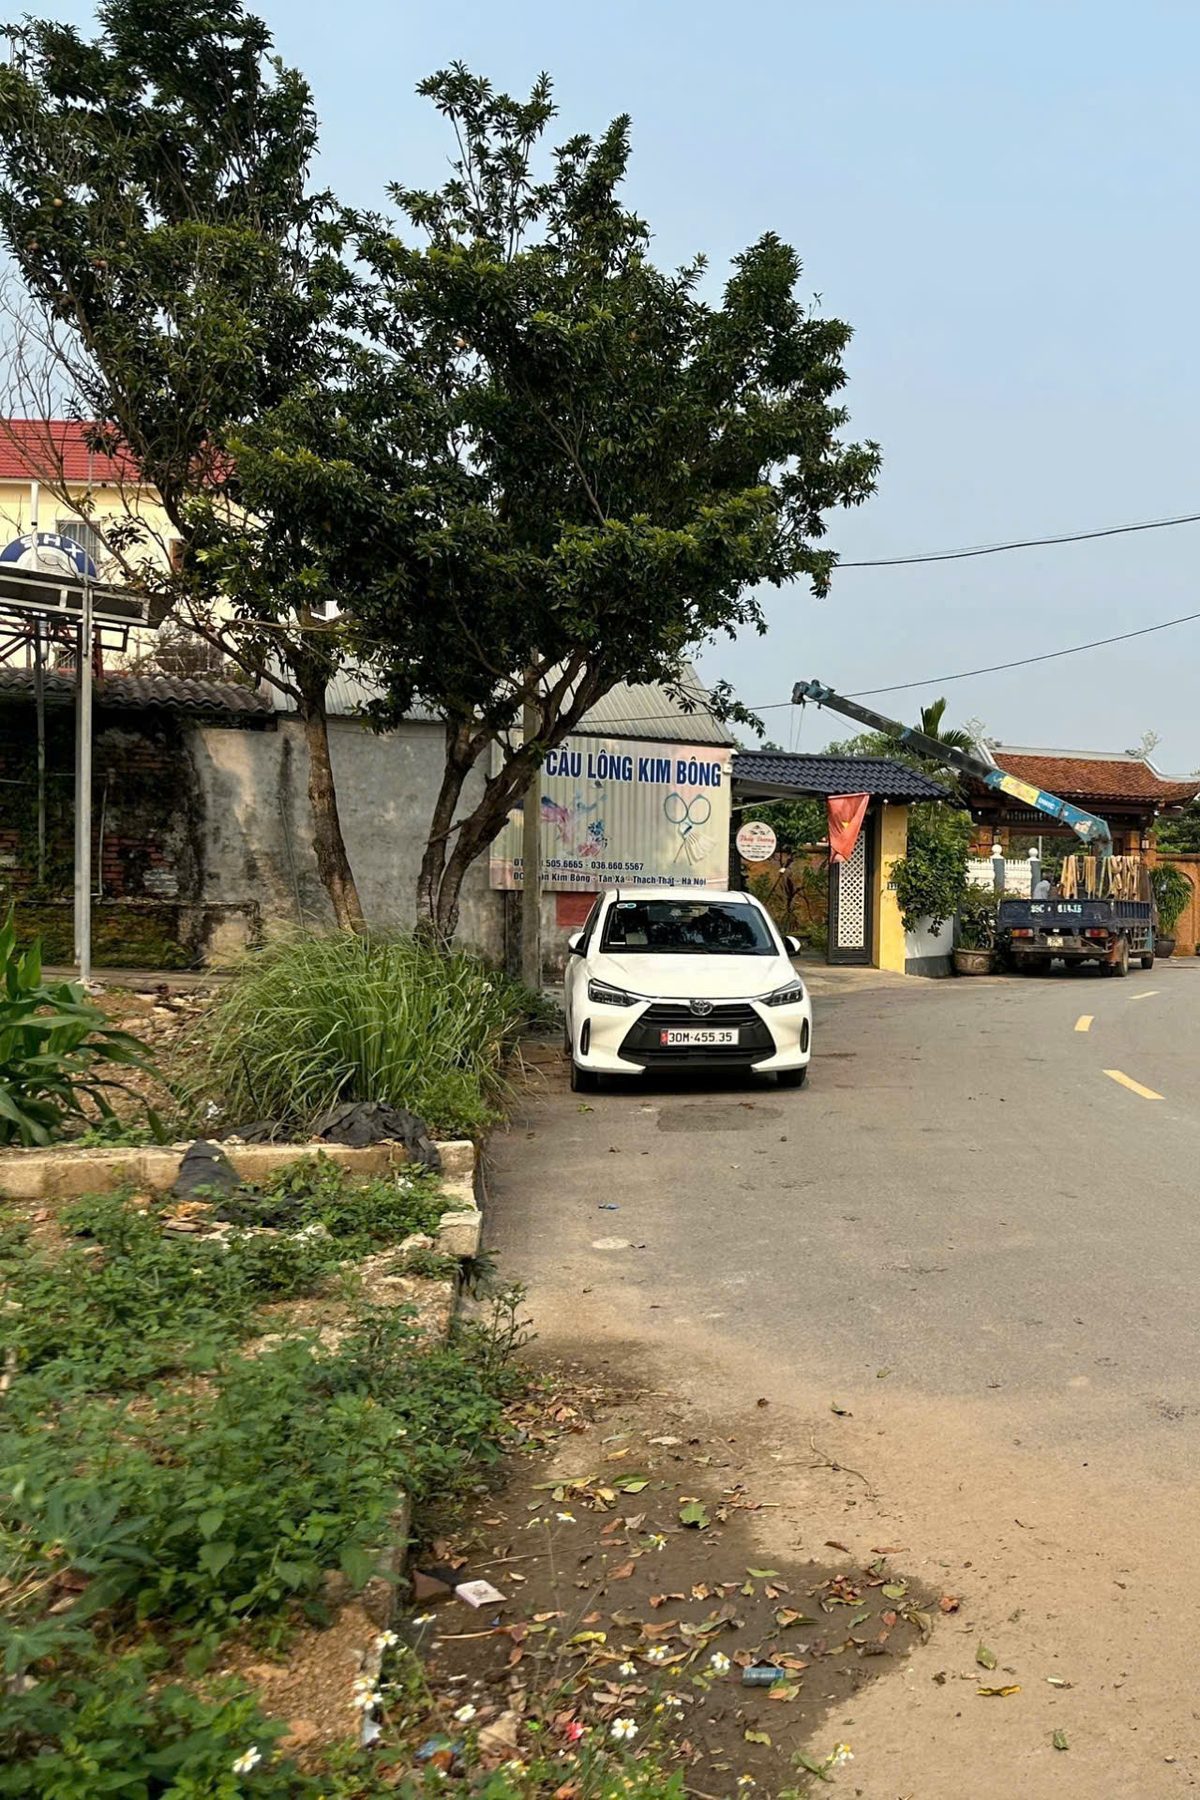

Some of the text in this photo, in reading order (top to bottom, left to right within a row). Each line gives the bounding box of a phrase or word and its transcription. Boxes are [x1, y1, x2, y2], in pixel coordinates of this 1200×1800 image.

[588, 749, 632, 781] LÔNG
[639, 757, 671, 784] KIM
[677, 756, 720, 787] BÔNG
